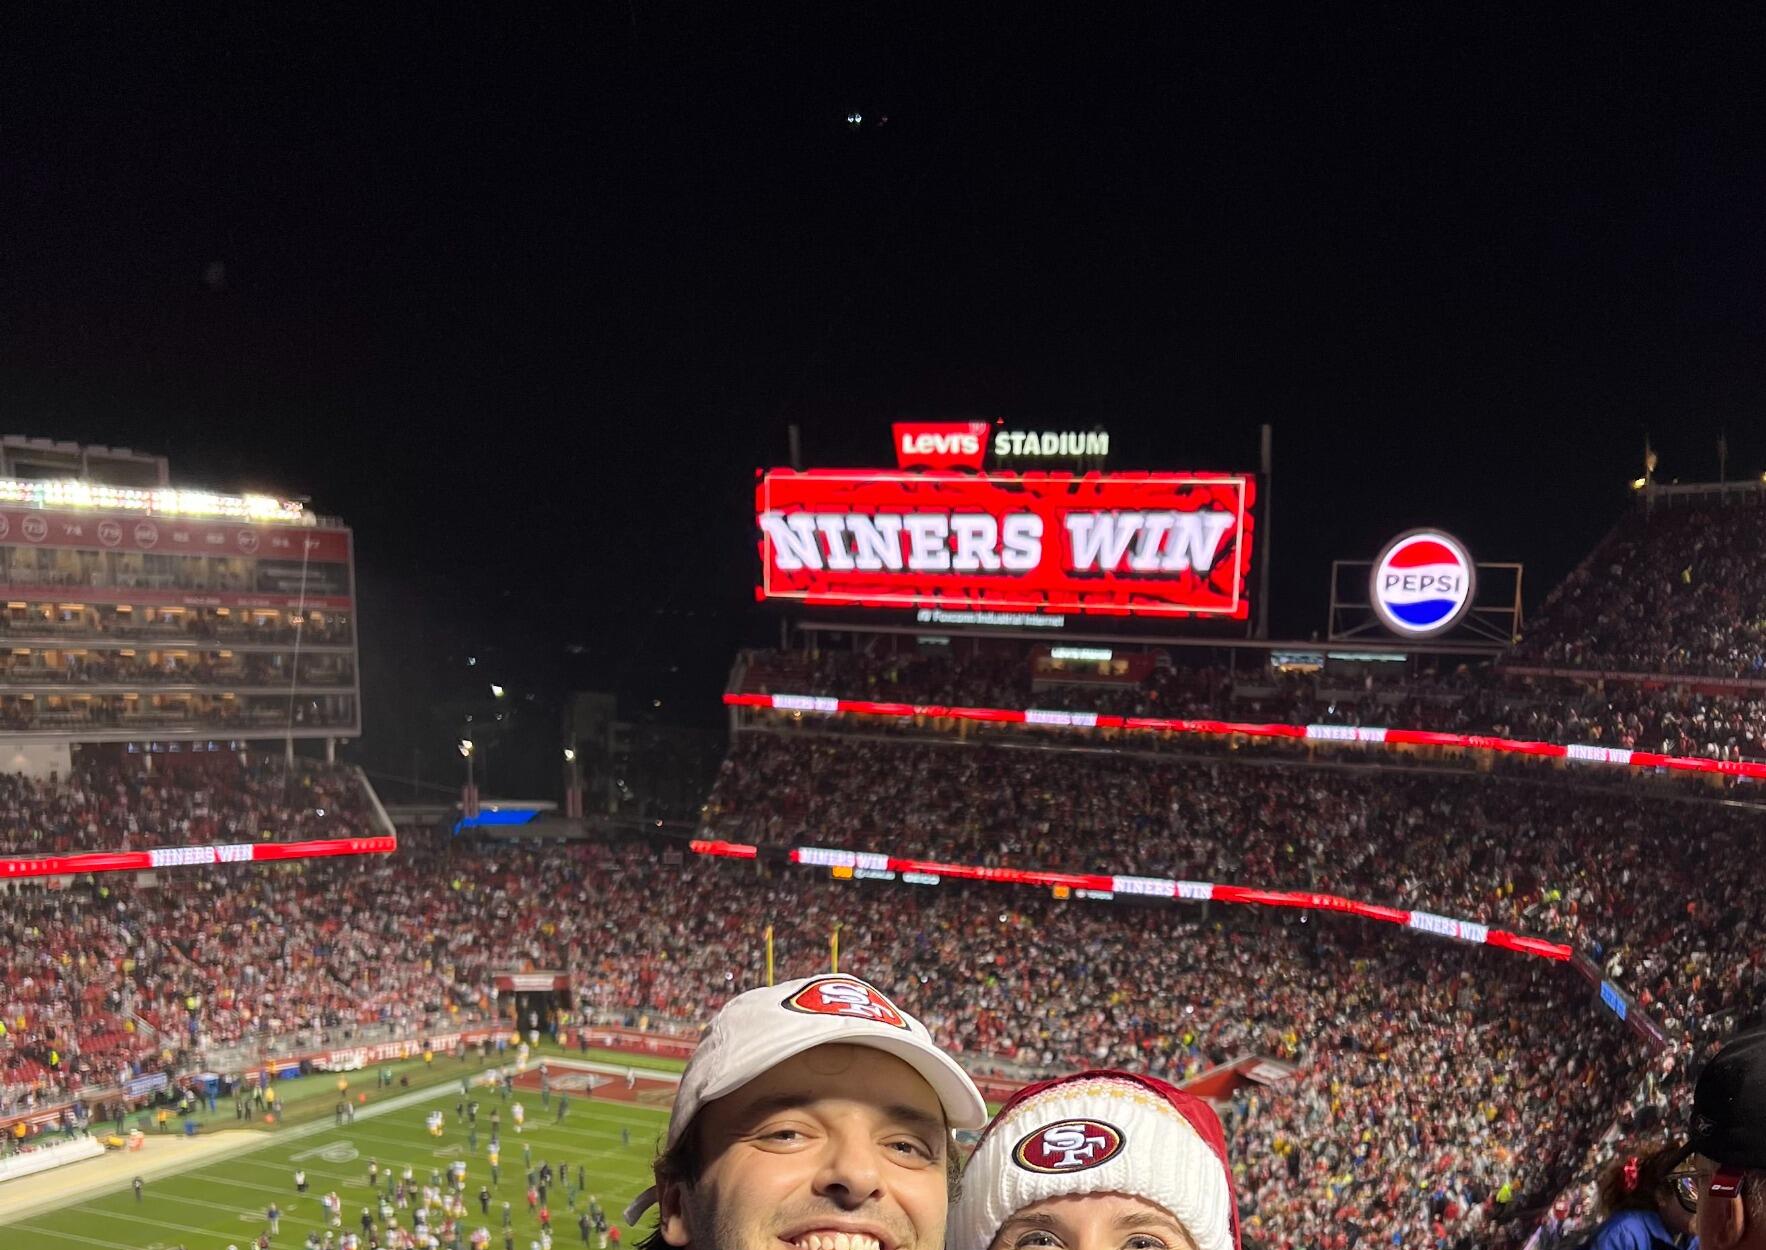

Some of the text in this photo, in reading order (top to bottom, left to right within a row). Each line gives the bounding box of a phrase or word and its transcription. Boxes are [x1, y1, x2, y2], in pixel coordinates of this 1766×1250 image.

[995, 431, 1109, 456] STADIUM
[759, 509, 1236, 572] NINERS WIN
[1385, 574, 1461, 593] PEPSI
[1307, 724, 1388, 742] NINERS WIN
[1567, 744, 1633, 764] NINERS WIN
[151, 844, 254, 867] NINERS WIN
[1113, 875, 1176, 896] NINERS
[1176, 880, 1214, 900] WIN
[1410, 911, 1489, 943] NINERS WIN
[818, 983, 896, 1019] SF
[1042, 1123, 1107, 1168] SF
